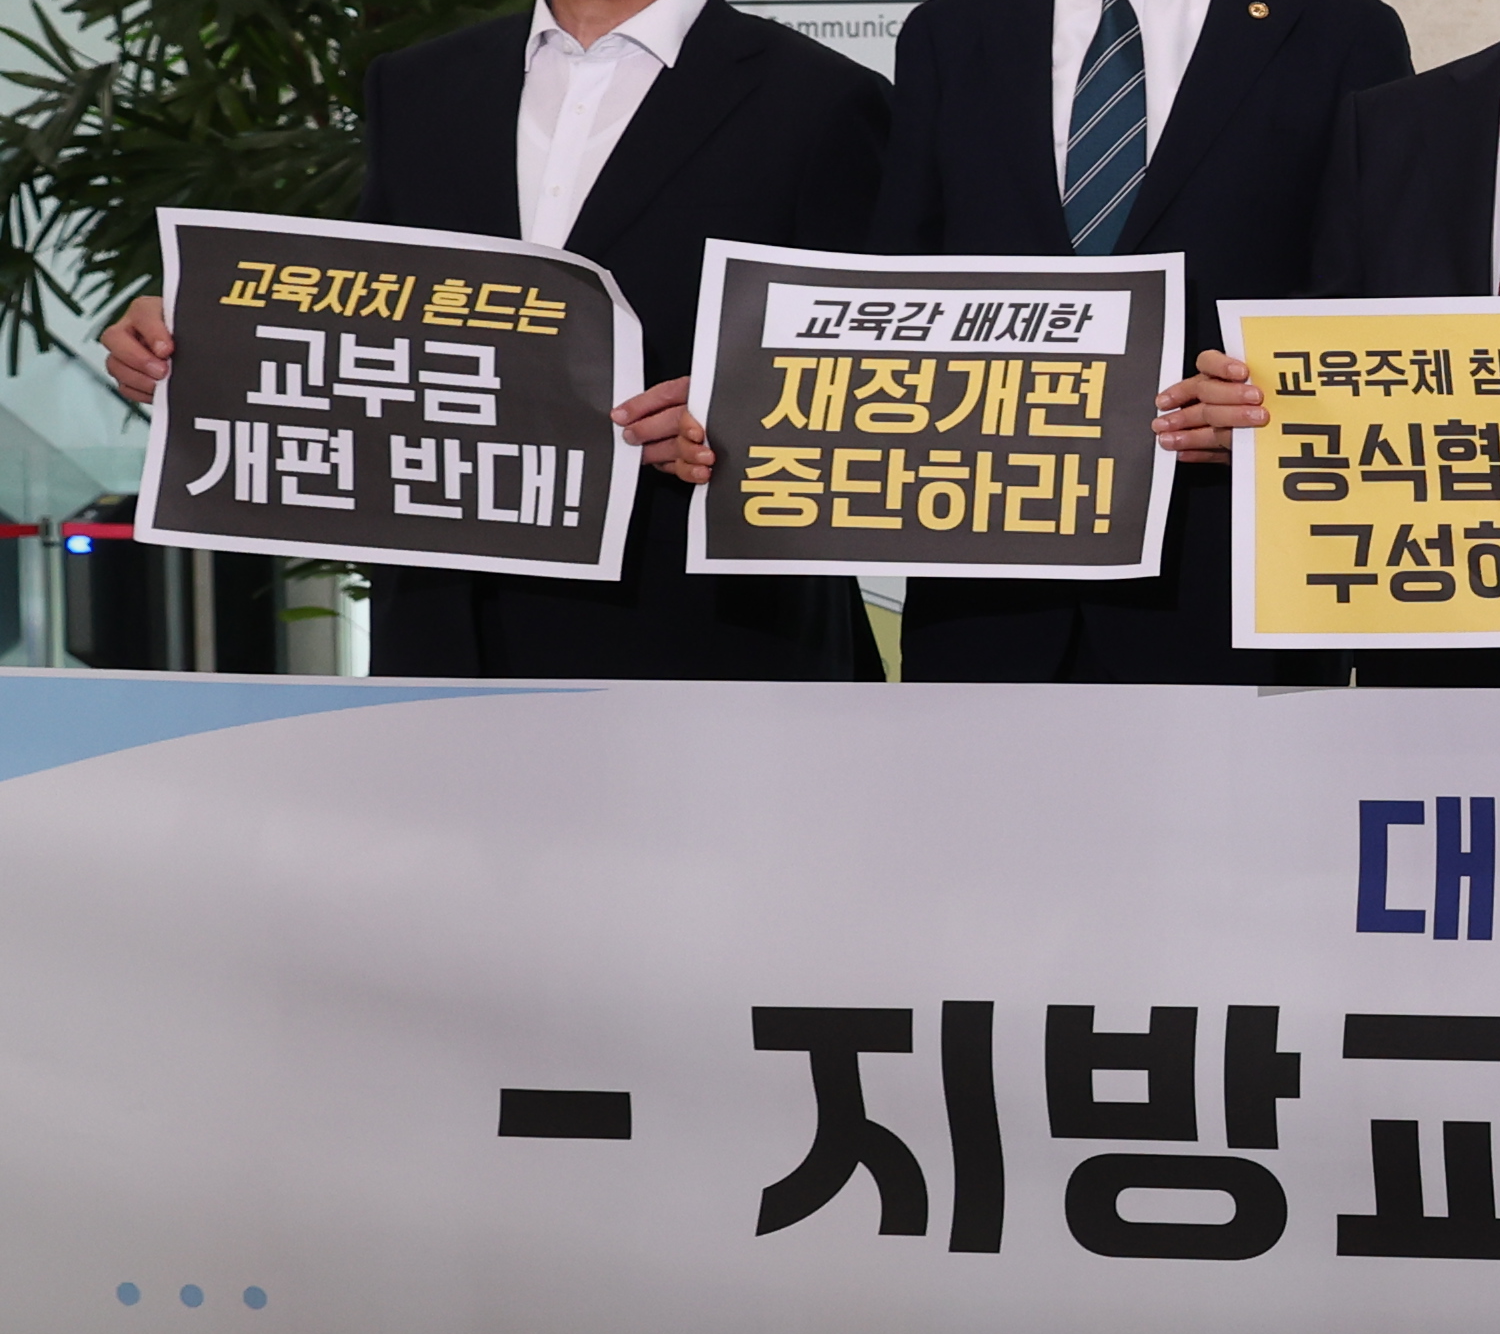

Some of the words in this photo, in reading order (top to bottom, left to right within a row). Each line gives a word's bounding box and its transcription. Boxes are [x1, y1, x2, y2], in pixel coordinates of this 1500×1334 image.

[768, 14, 904, 38] mmunic
[219, 261, 417, 321] 교육자치
[422, 278, 567, 335] 흔드는
[795, 299, 945, 342] 교육감
[950, 302, 1094, 343] 배제한
[246, 325, 501, 426] 교부금
[760, 356, 1108, 442] 재정개편
[1273, 348, 1454, 397] 교육주체
[186, 417, 355, 510] 개편
[390, 434, 585, 527] 반대!
[740, 445, 1115, 536] 중단하라!
